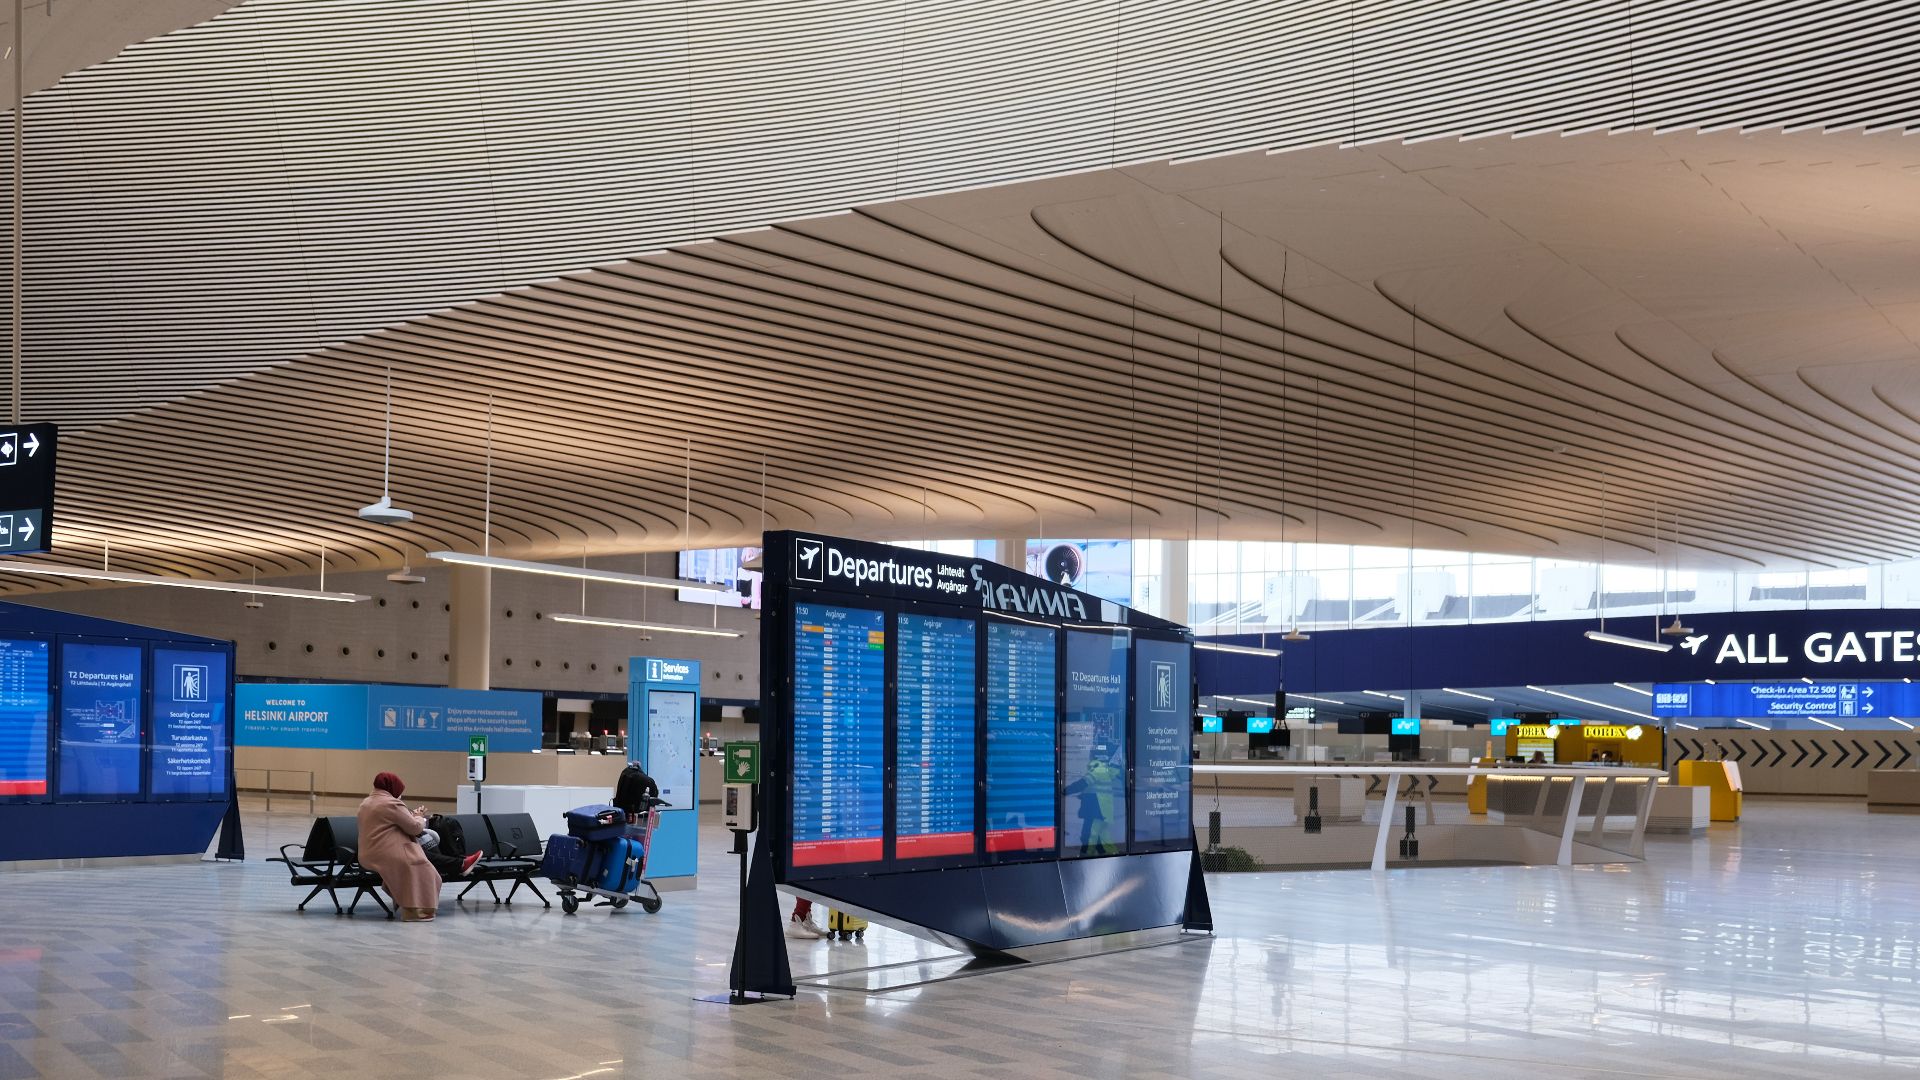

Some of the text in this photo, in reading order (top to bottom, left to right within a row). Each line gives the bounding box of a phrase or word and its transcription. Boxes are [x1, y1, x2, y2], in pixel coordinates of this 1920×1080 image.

[828, 547, 933, 588] Departures
[937, 579, 968, 595] Avgångar
[796, 607, 808, 616] 11:50
[826, 610, 847, 620] Avgångar
[1715, 631, 1920, 664] ALL GATE
[663, 662, 689, 674] Services
[68, 671, 78, 679] T2
[79, 672, 118, 681] Departures
[1072, 672, 1120, 684] T2 Departures Hall
[1750, 686, 1786, 694] Check-in
[1788, 686, 1808, 694] Area
[448, 707, 462, 716] Enjoy
[1770, 702, 1836, 712] Security Control
[244, 710, 329, 722] HELSINKI AIRPORT
[1584, 726, 1627, 737] FOREX
